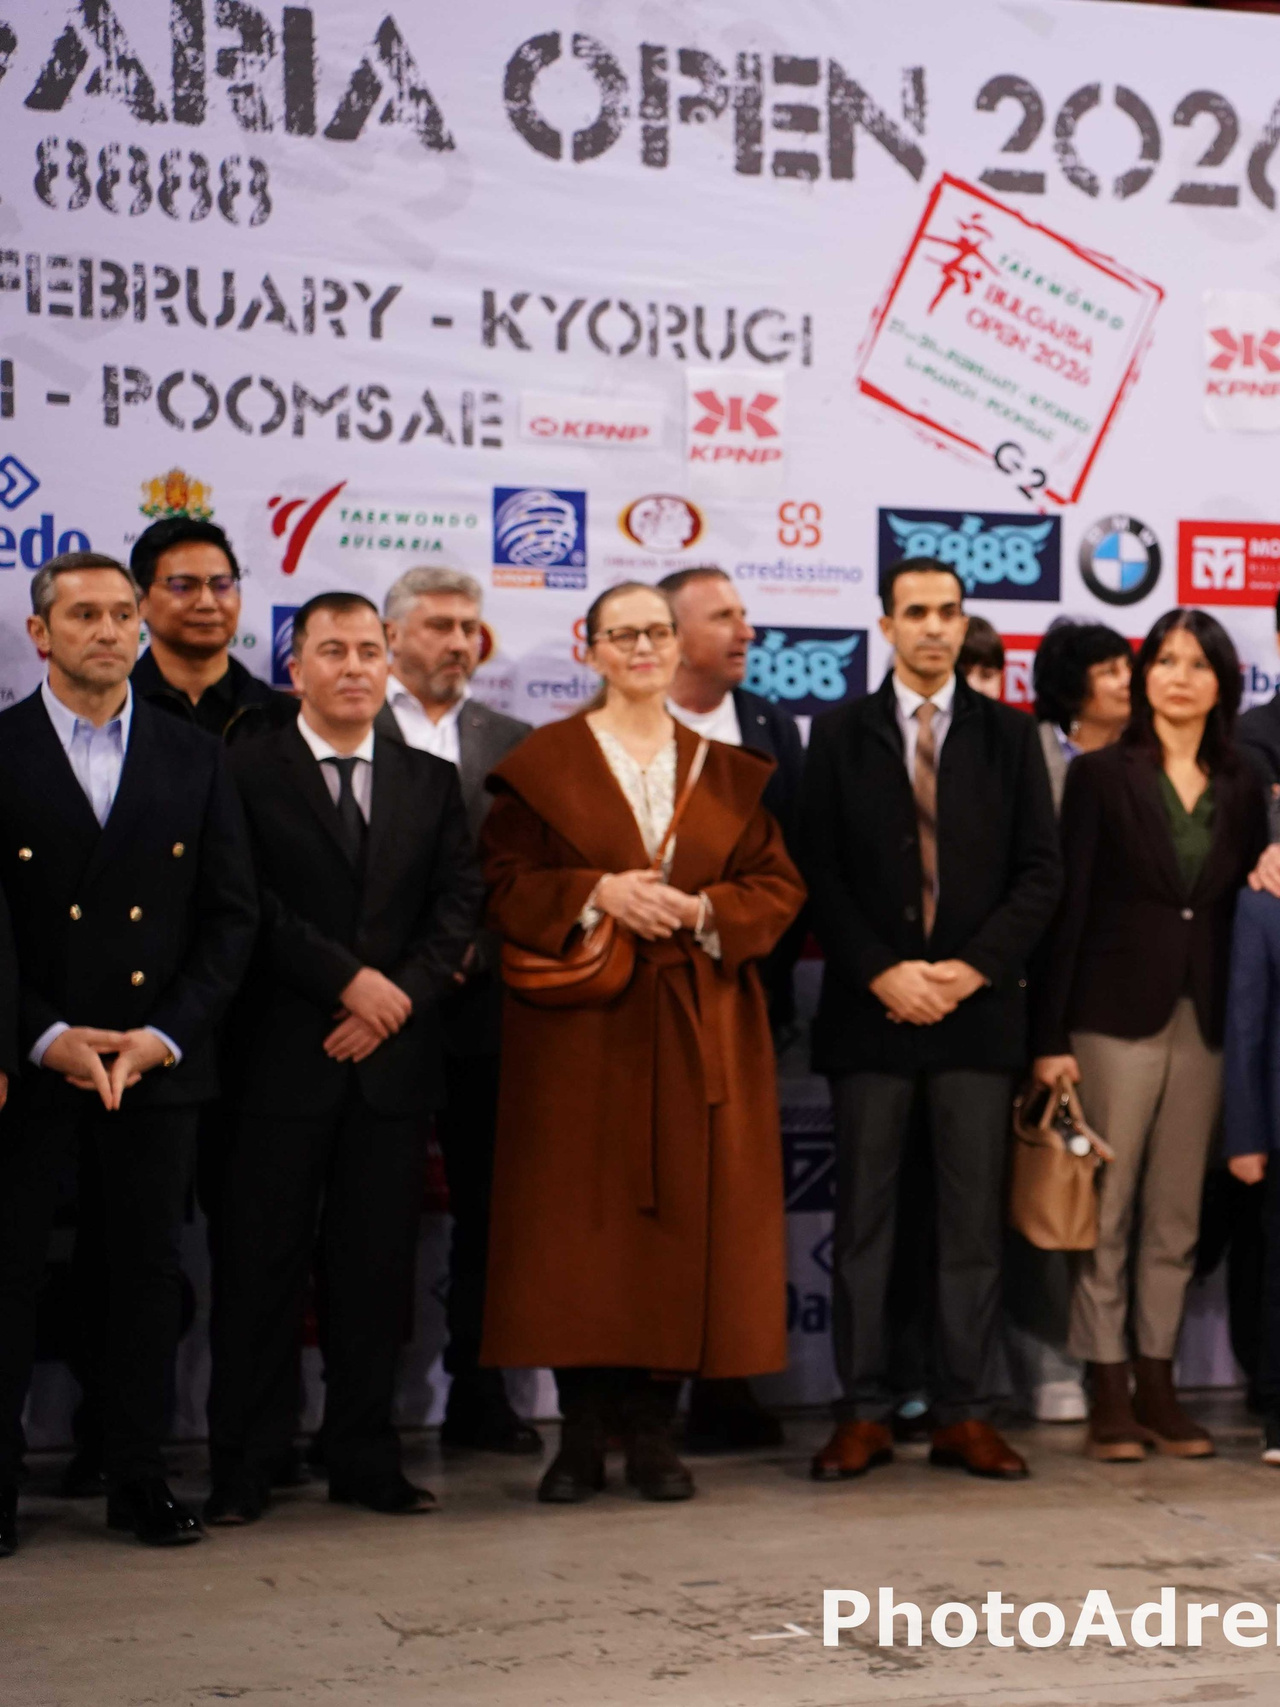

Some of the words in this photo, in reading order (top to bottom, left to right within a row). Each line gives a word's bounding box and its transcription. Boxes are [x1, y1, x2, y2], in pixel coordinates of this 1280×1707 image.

[0, 0, 456, 152] ARIA
[503, 31, 926, 183] OPEN
[33, 135, 273, 227] 8888
[481, 289, 812, 367] KYORUGI
[102, 364, 503, 449] POOMSAE
[562, 420, 650, 441] KPNP
[689, 446, 783, 474] KPNP
[339, 508, 479, 529] TAEKWONDO
[339, 534, 444, 551] BULGARIA
[735, 558, 865, 583] credissimo
[744, 648, 848, 701] 888
